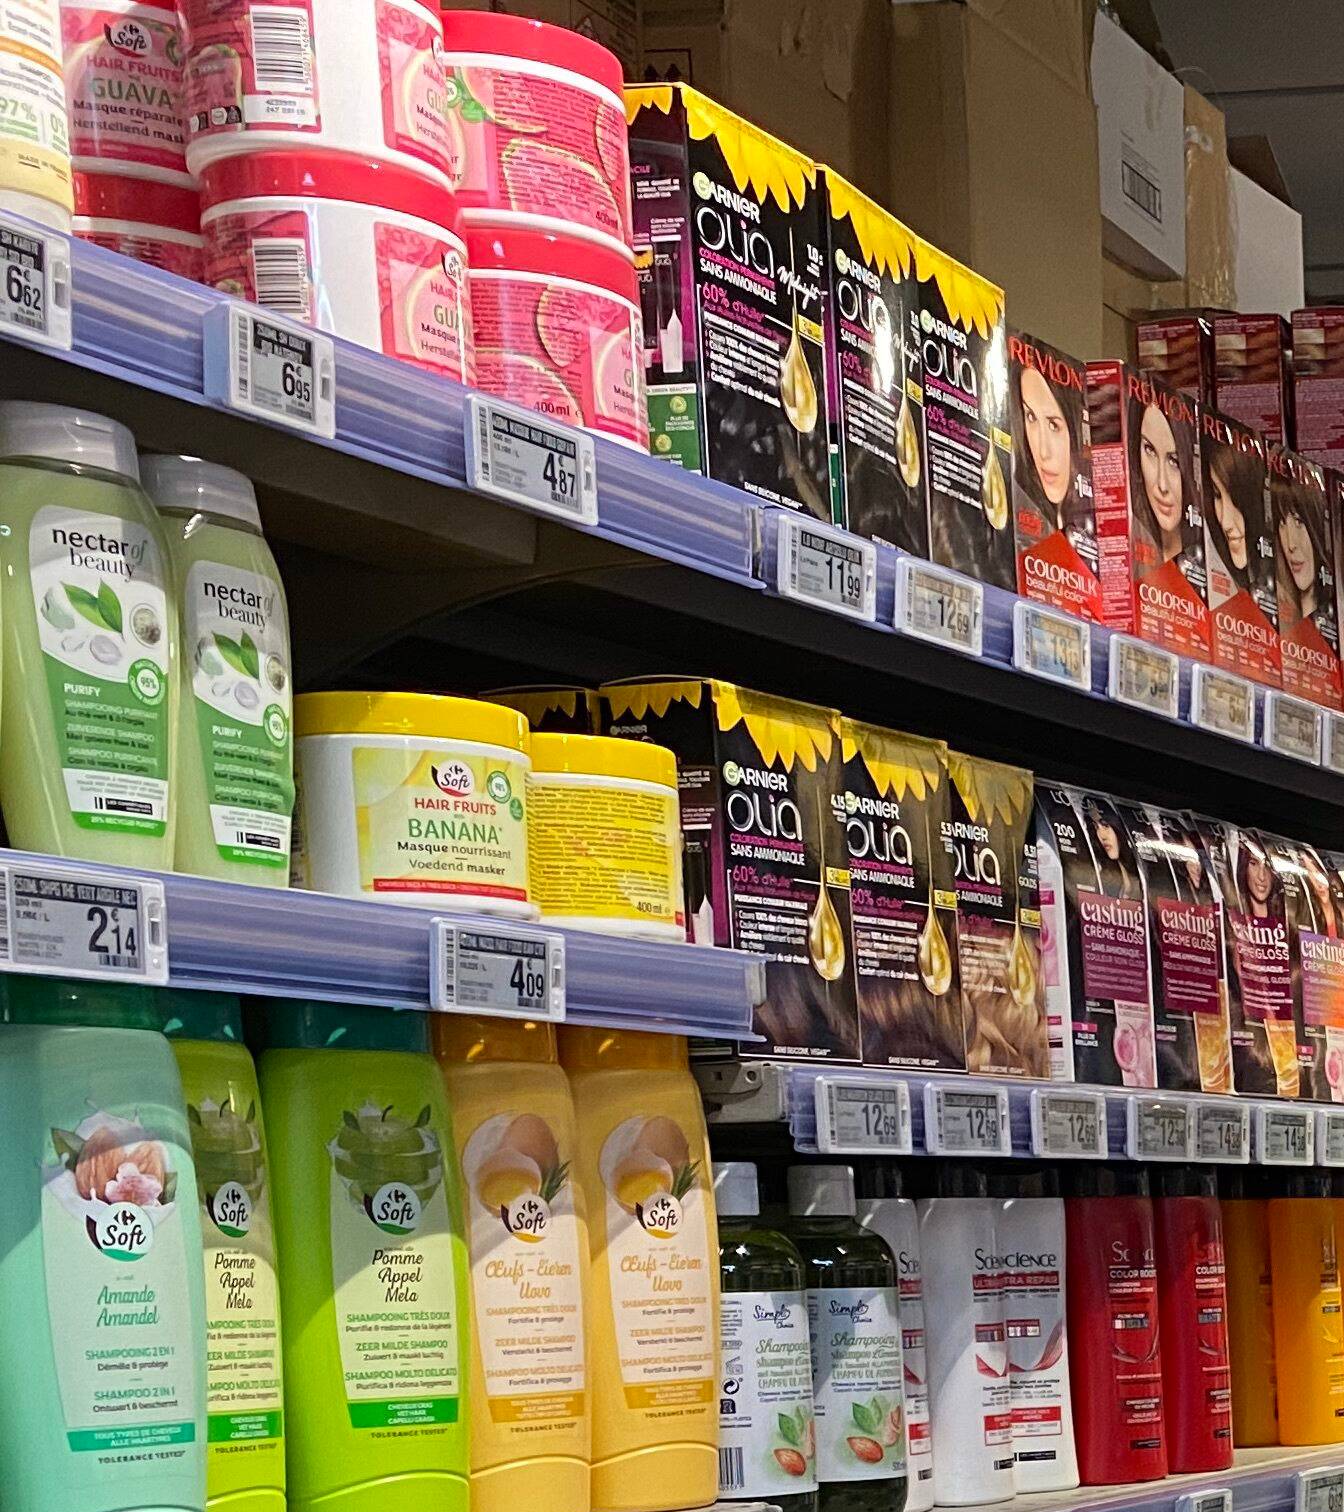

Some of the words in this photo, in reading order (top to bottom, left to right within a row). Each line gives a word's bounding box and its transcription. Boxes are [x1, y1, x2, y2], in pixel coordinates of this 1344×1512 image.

[86, 55, 130, 73] HAIR
[92, 77, 174, 108] GUAVA
[694, 171, 761, 224] GARNIER
[920, 309, 967, 349] GARNIER
[1008, 336, 1084, 392] REVLON
[1128, 376, 1196, 423] REVLON
[52, 526, 128, 557] nectar
[68, 549, 135, 581] beauty
[1024, 555, 1098, 596] COLORSILK
[203, 580, 262, 609] nectar
[1139, 584, 1207, 622] COLORSILK
[218, 601, 268, 629] beauty
[1215, 611, 1278, 648] COLORSILK
[1280, 639, 1338, 673] COLORSILK
[63, 682, 101, 697] PURIFY
[212, 725, 242, 738] PURIFY
[440, 771, 471, 791] Soft
[723, 761, 788, 793] GARNIER
[414, 797, 448, 813] HAIR
[451, 800, 497, 816] FRUITS
[844, 791, 899, 821] GARNIER
[397, 841, 449, 855] Masque
[452, 844, 512, 860] nourrissant
[730, 842, 753, 858] SANS
[754, 846, 805, 866] AMMONIAQUE
[409, 859, 464, 874] Voedend
[466, 863, 506, 877] masker
[1080, 900, 1144, 937] casting
[1161, 906, 1215, 940] casting
[1116, 928, 1144, 946] GLOSS
[1191, 938, 1216, 951] GLOSS
[1300, 942, 1344, 966] casting
[100, 1219, 147, 1251] Soft
[214, 1252, 256, 1272] Pomme
[372, 1249, 424, 1271] Pomme
[218, 1270, 255, 1294] Appel
[378, 1266, 422, 1291] Appel
[97, 1284, 155, 1307] Amande
[224, 1290, 253, 1311] Mela
[382, 1284, 418, 1304] Mela
[97, 1306, 160, 1328] Amandel
[355, 1341, 378, 1352] ZEER
[408, 1340, 446, 1350] SHAMPOO
[345, 1371, 391, 1382] SHAMPOO
